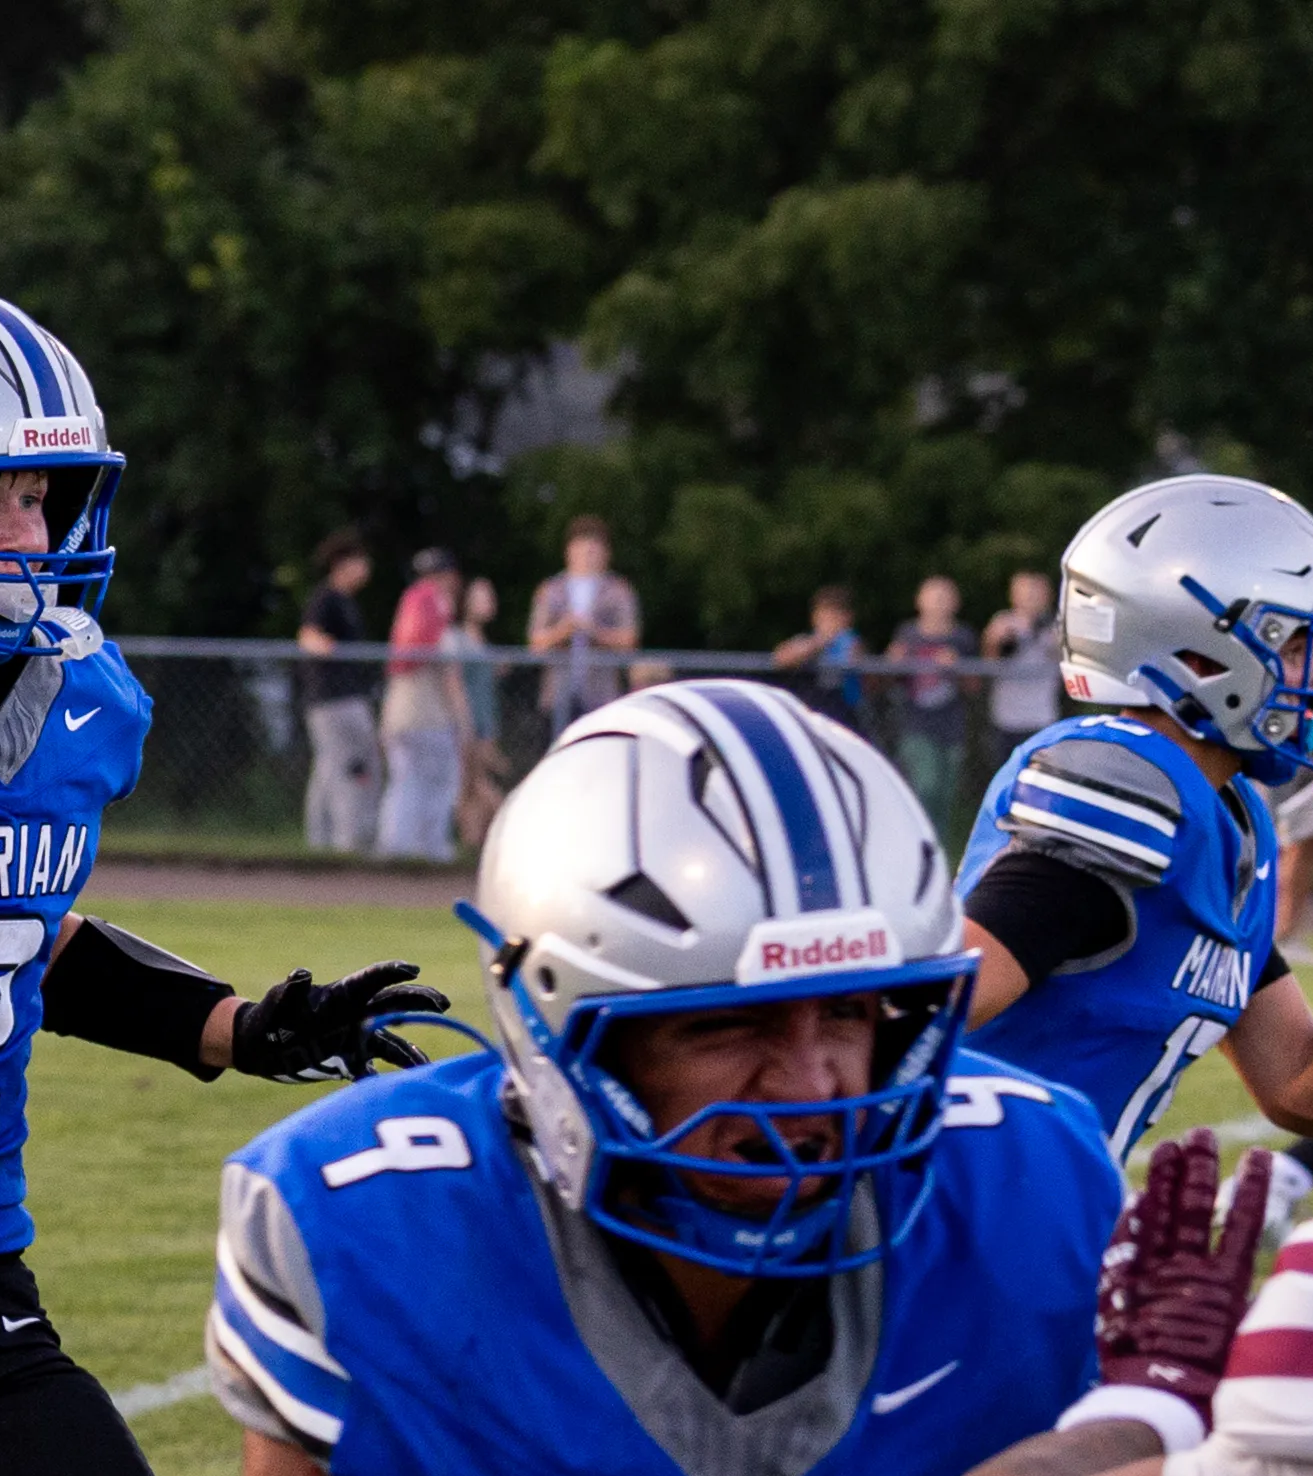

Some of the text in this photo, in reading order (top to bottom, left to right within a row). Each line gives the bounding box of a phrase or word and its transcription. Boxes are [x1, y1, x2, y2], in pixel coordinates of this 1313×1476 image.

[23, 427, 91, 448] Riddell
[761, 930, 888, 971] Riddell
[320, 1115, 472, 1189] 9
